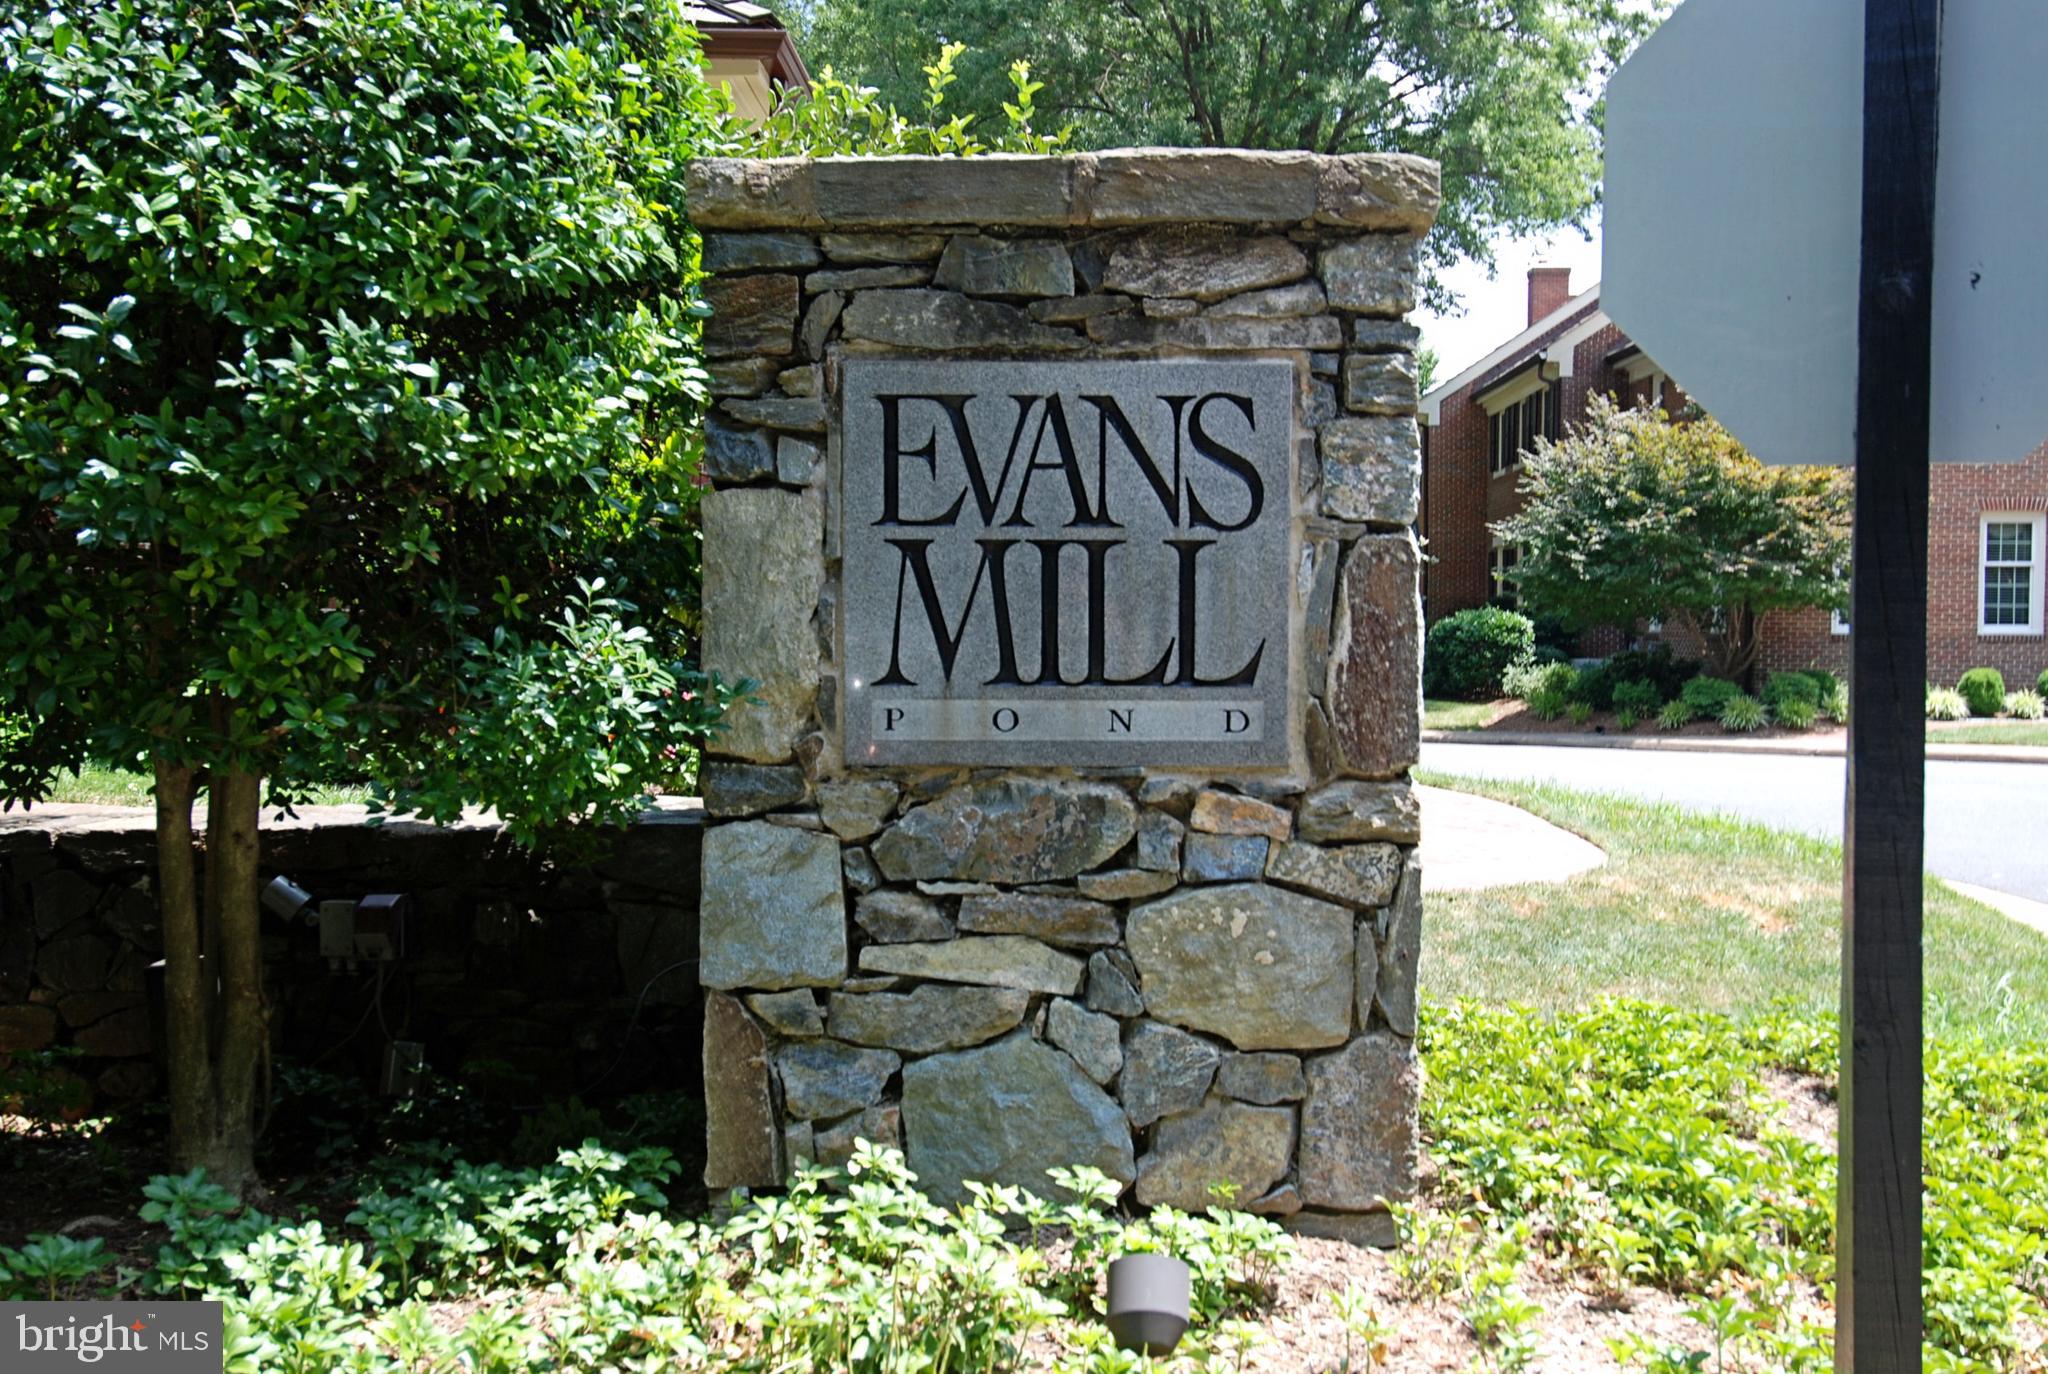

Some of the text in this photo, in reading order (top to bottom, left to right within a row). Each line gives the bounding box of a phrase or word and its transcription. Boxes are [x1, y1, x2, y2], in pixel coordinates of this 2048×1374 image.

[871, 392, 1265, 532] EVANS
[871, 539, 1266, 687] MILL
[884, 707, 1250, 733] POND
